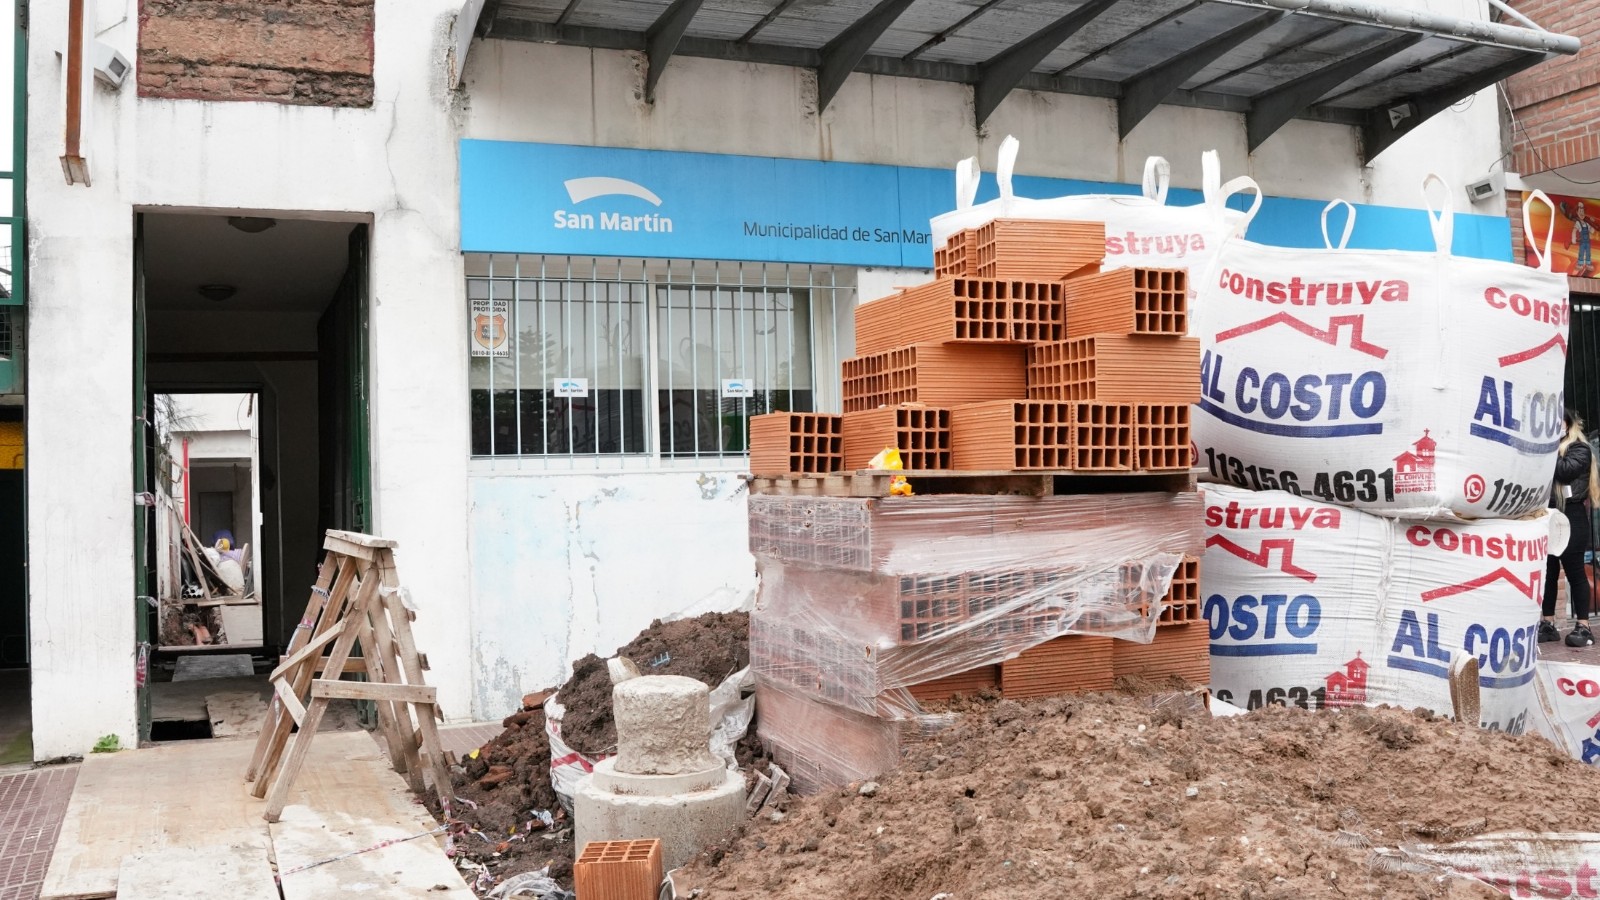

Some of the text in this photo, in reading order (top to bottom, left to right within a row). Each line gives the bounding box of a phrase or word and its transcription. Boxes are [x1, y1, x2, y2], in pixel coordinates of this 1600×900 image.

[553, 209, 673, 233] San Martín
[743, 221, 933, 245] Municipalidad de San Mar
[1105, 231, 1205, 259] struya
[1219, 268, 1409, 306] construya
[1484, 286, 1570, 326] const
[1200, 349, 1387, 422] AL COSTO
[1474, 375, 1565, 438] AL COS
[1204, 447, 1395, 503] 113156-4631
[1205, 501, 1341, 530] struya
[1203, 594, 1322, 641] OSTO
[1391, 609, 1451, 663] AL
